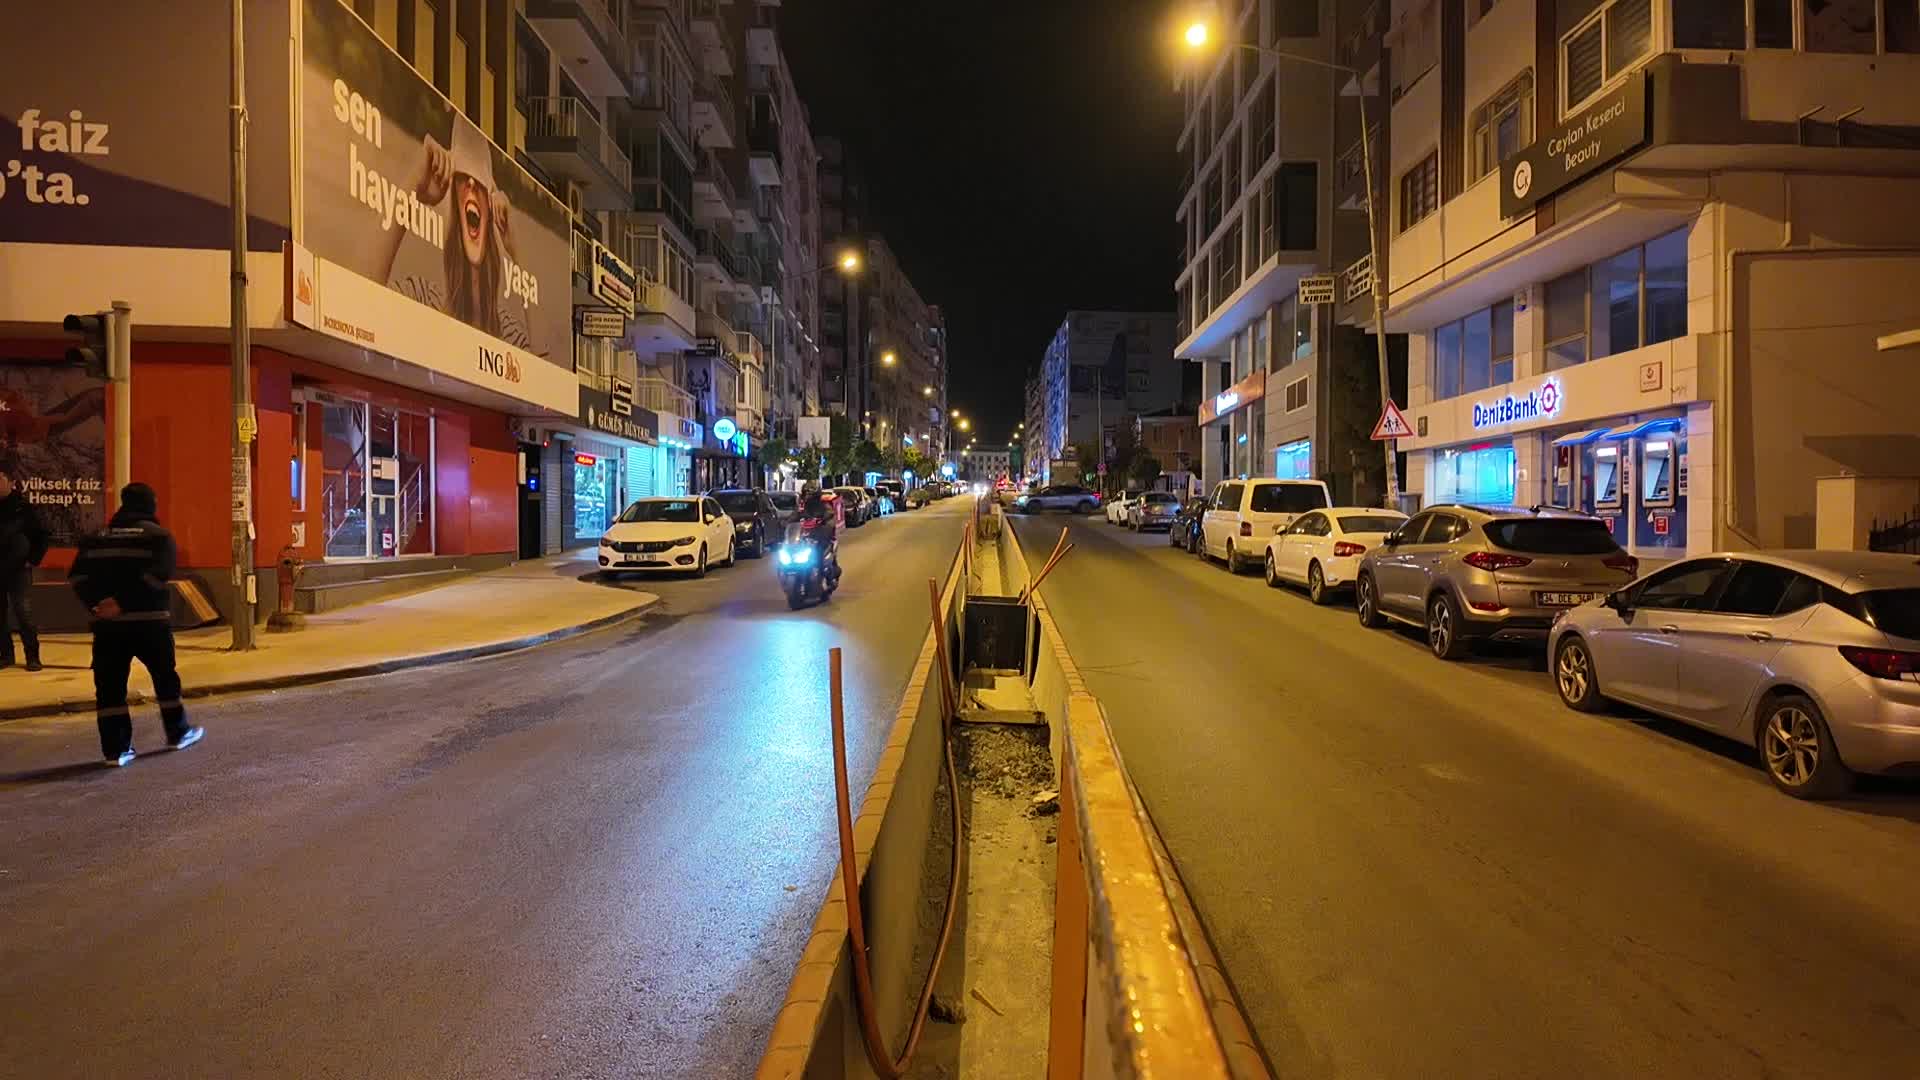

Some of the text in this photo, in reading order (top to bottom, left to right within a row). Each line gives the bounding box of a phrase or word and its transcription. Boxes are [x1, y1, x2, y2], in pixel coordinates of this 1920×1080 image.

[17, 108, 110, 155] faiz
[333, 78, 382, 150] sen
[1547, 96, 1625, 157] Ceylan Keserci
[1565, 140, 1601, 172] Beauty
[350, 142, 445, 250] hayatını
[503, 257, 539, 309] yaşa
[478, 345, 504, 377] ING
[1474, 391, 1539, 428] DenizBank
[21, 477, 71, 493] yüksek
[76, 477, 101, 490] faiz
[29, 491, 95, 507] Hesap'ta.
